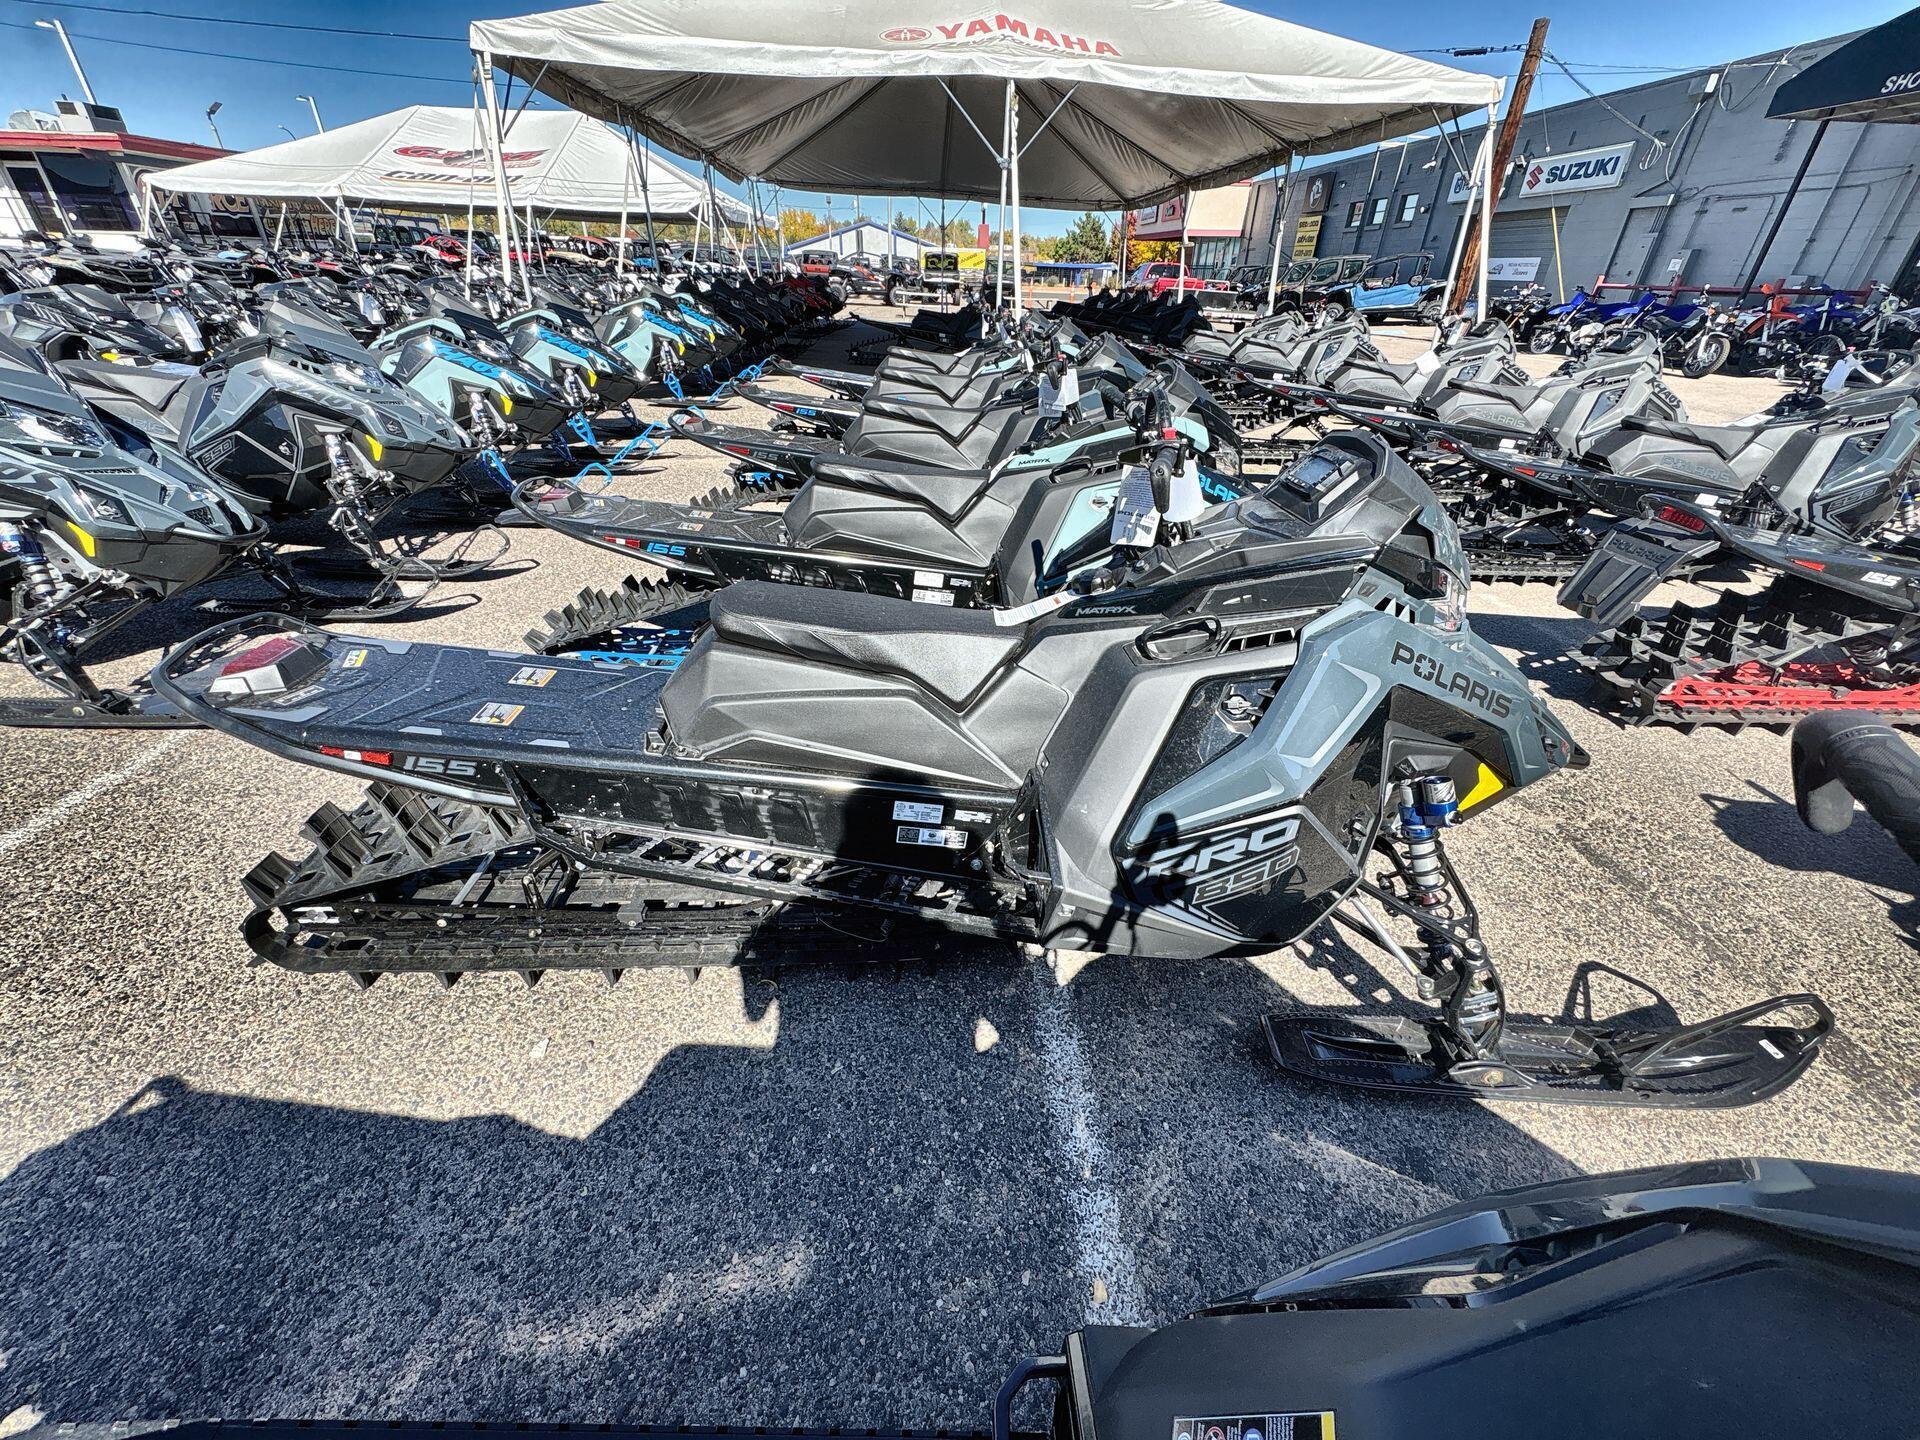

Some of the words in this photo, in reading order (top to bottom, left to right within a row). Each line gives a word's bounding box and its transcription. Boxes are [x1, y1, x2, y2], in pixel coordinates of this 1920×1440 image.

[936, 14, 1122, 57] YAMAHA
[1545, 155, 1621, 184] SUZUKI
[1496, 355, 1529, 382] KHAOS
[1645, 376, 1681, 409] KHAOS
[795, 407, 816, 416] 155
[752, 450, 778, 461] 155
[1535, 471, 1559, 481] 155
[647, 542, 687, 557] 155
[1860, 571, 1902, 587] 155
[1075, 605, 1138, 617] MATRYX
[1390, 640, 1513, 719] POLARIS
[403, 755, 478, 776] 155
[1192, 846, 1301, 905] 850
